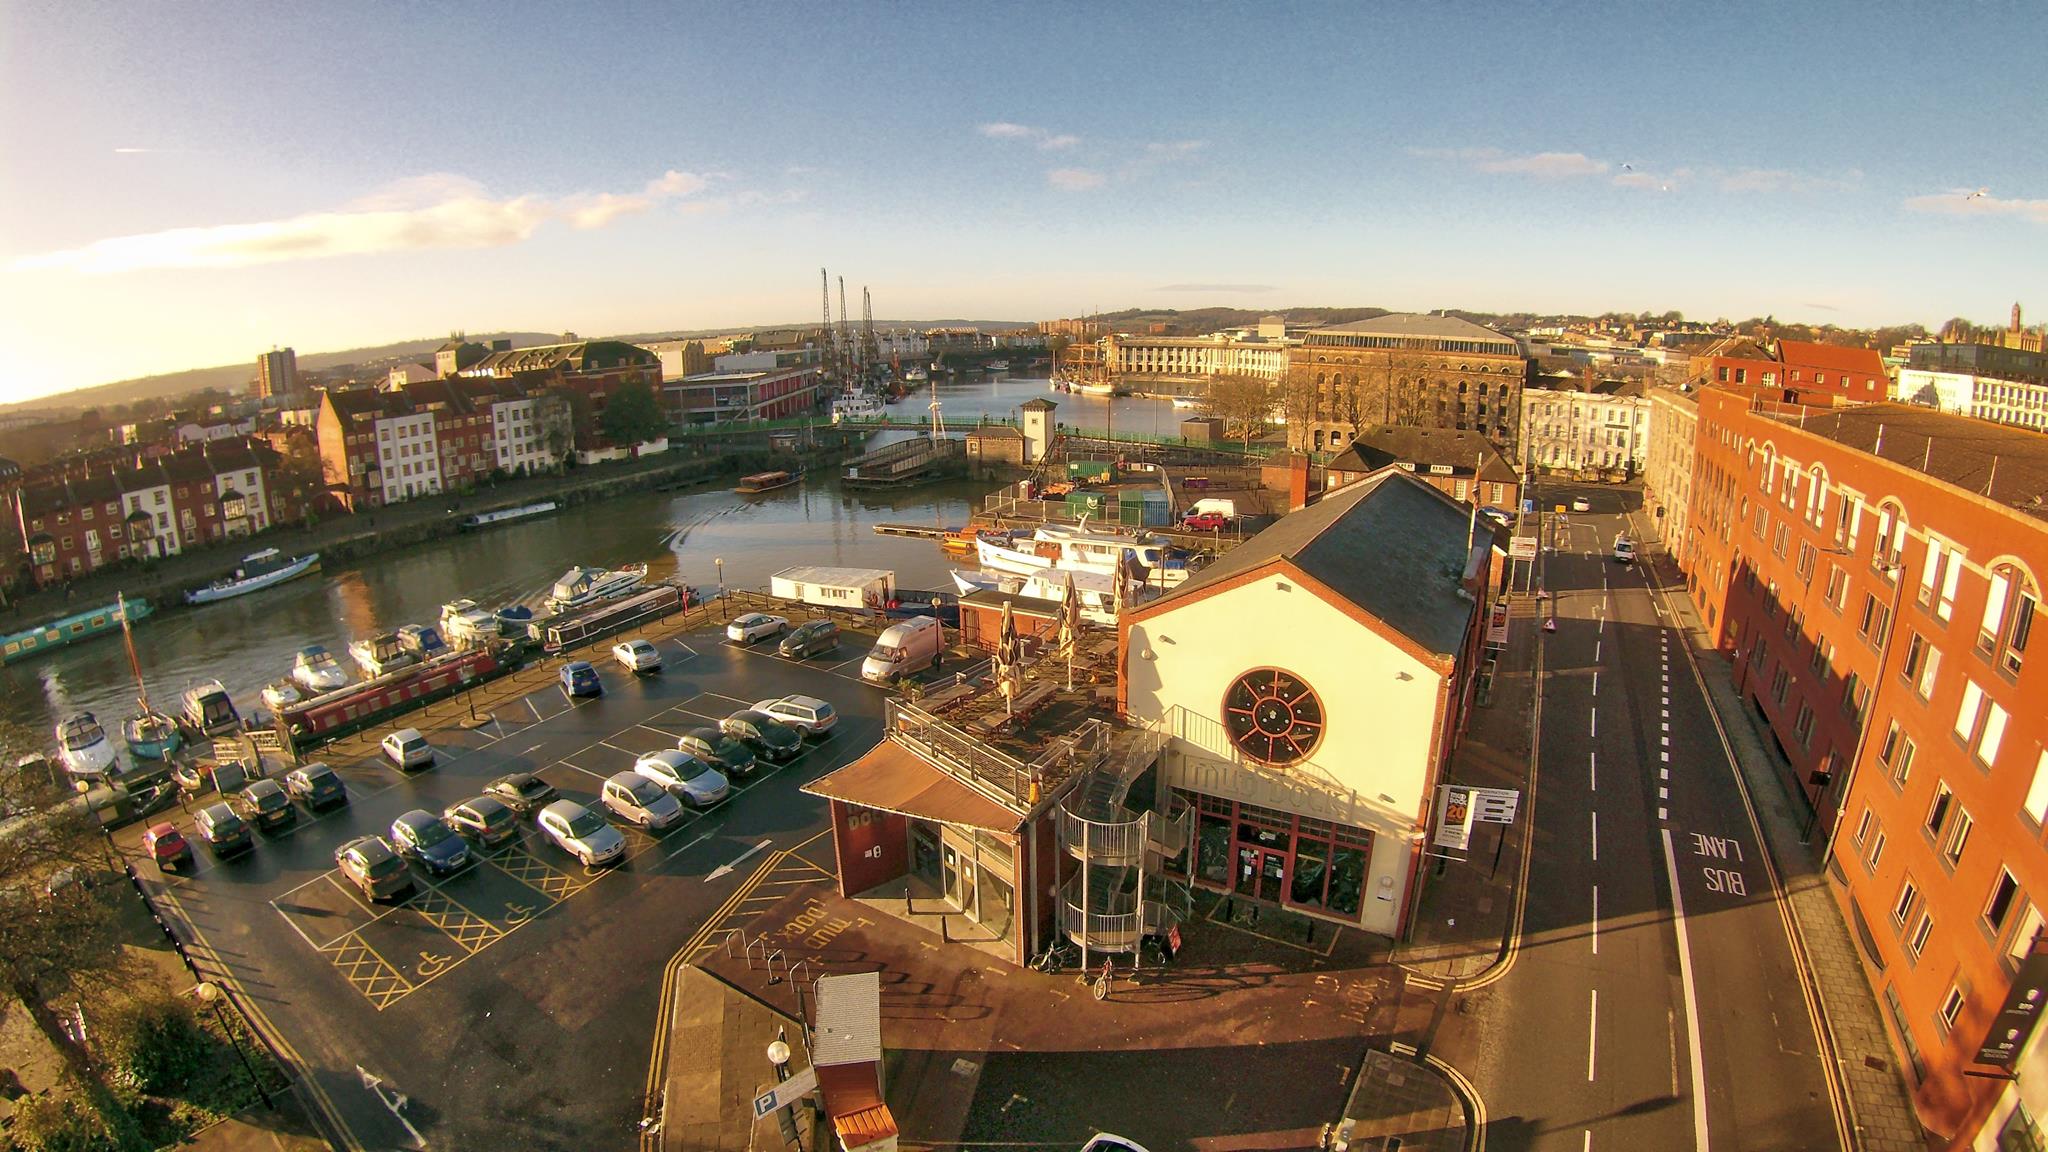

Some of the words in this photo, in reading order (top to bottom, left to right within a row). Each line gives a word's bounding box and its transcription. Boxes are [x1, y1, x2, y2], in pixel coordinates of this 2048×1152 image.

[1447, 805, 1466, 818] 20
[1690, 832, 1743, 862] LANE
[1703, 867, 1747, 897] BUS
[759, 1095, 773, 1114] P
